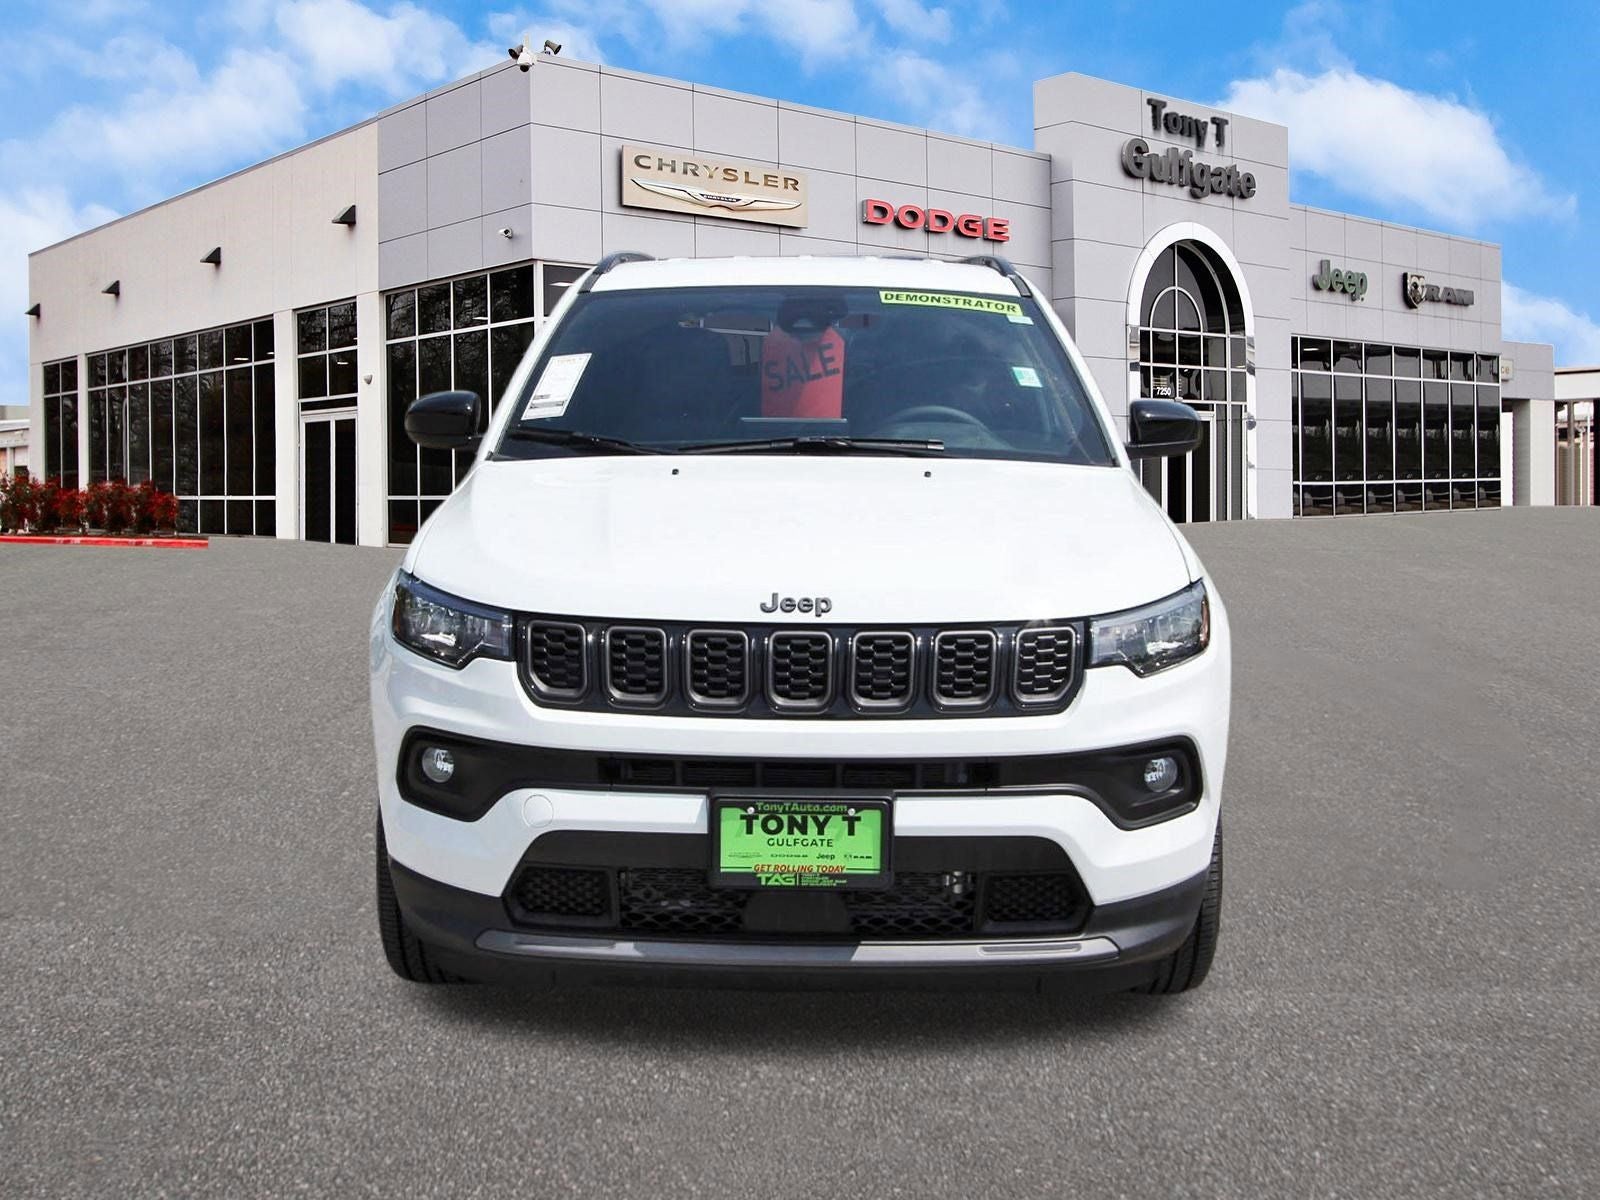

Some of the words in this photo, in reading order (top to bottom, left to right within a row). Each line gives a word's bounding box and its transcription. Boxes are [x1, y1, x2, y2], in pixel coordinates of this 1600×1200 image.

[1147, 98, 1208, 148] Tony
[1210, 117, 1229, 147] T
[633, 153, 800, 192] CHRYSLER
[1121, 138, 1257, 199] Gulfgate
[863, 198, 1011, 242] DODGE
[1312, 259, 1368, 302] Jeep
[884, 292, 1018, 313] DEMONSTRATOR
[1424, 283, 1475, 307] RAM
[765, 342, 841, 393] SALE
[1156, 386, 1171, 396] 7250
[760, 592, 832, 618] Jeep
[756, 802, 848, 813] TonyTAuto.com
[740, 814, 832, 836] TONY
[841, 815, 861, 836] T
[767, 838, 833, 848] GULFGATE
[754, 864, 773, 873] GET
[774, 864, 813, 873] ROLLING
[816, 865, 846, 874] TODAY
